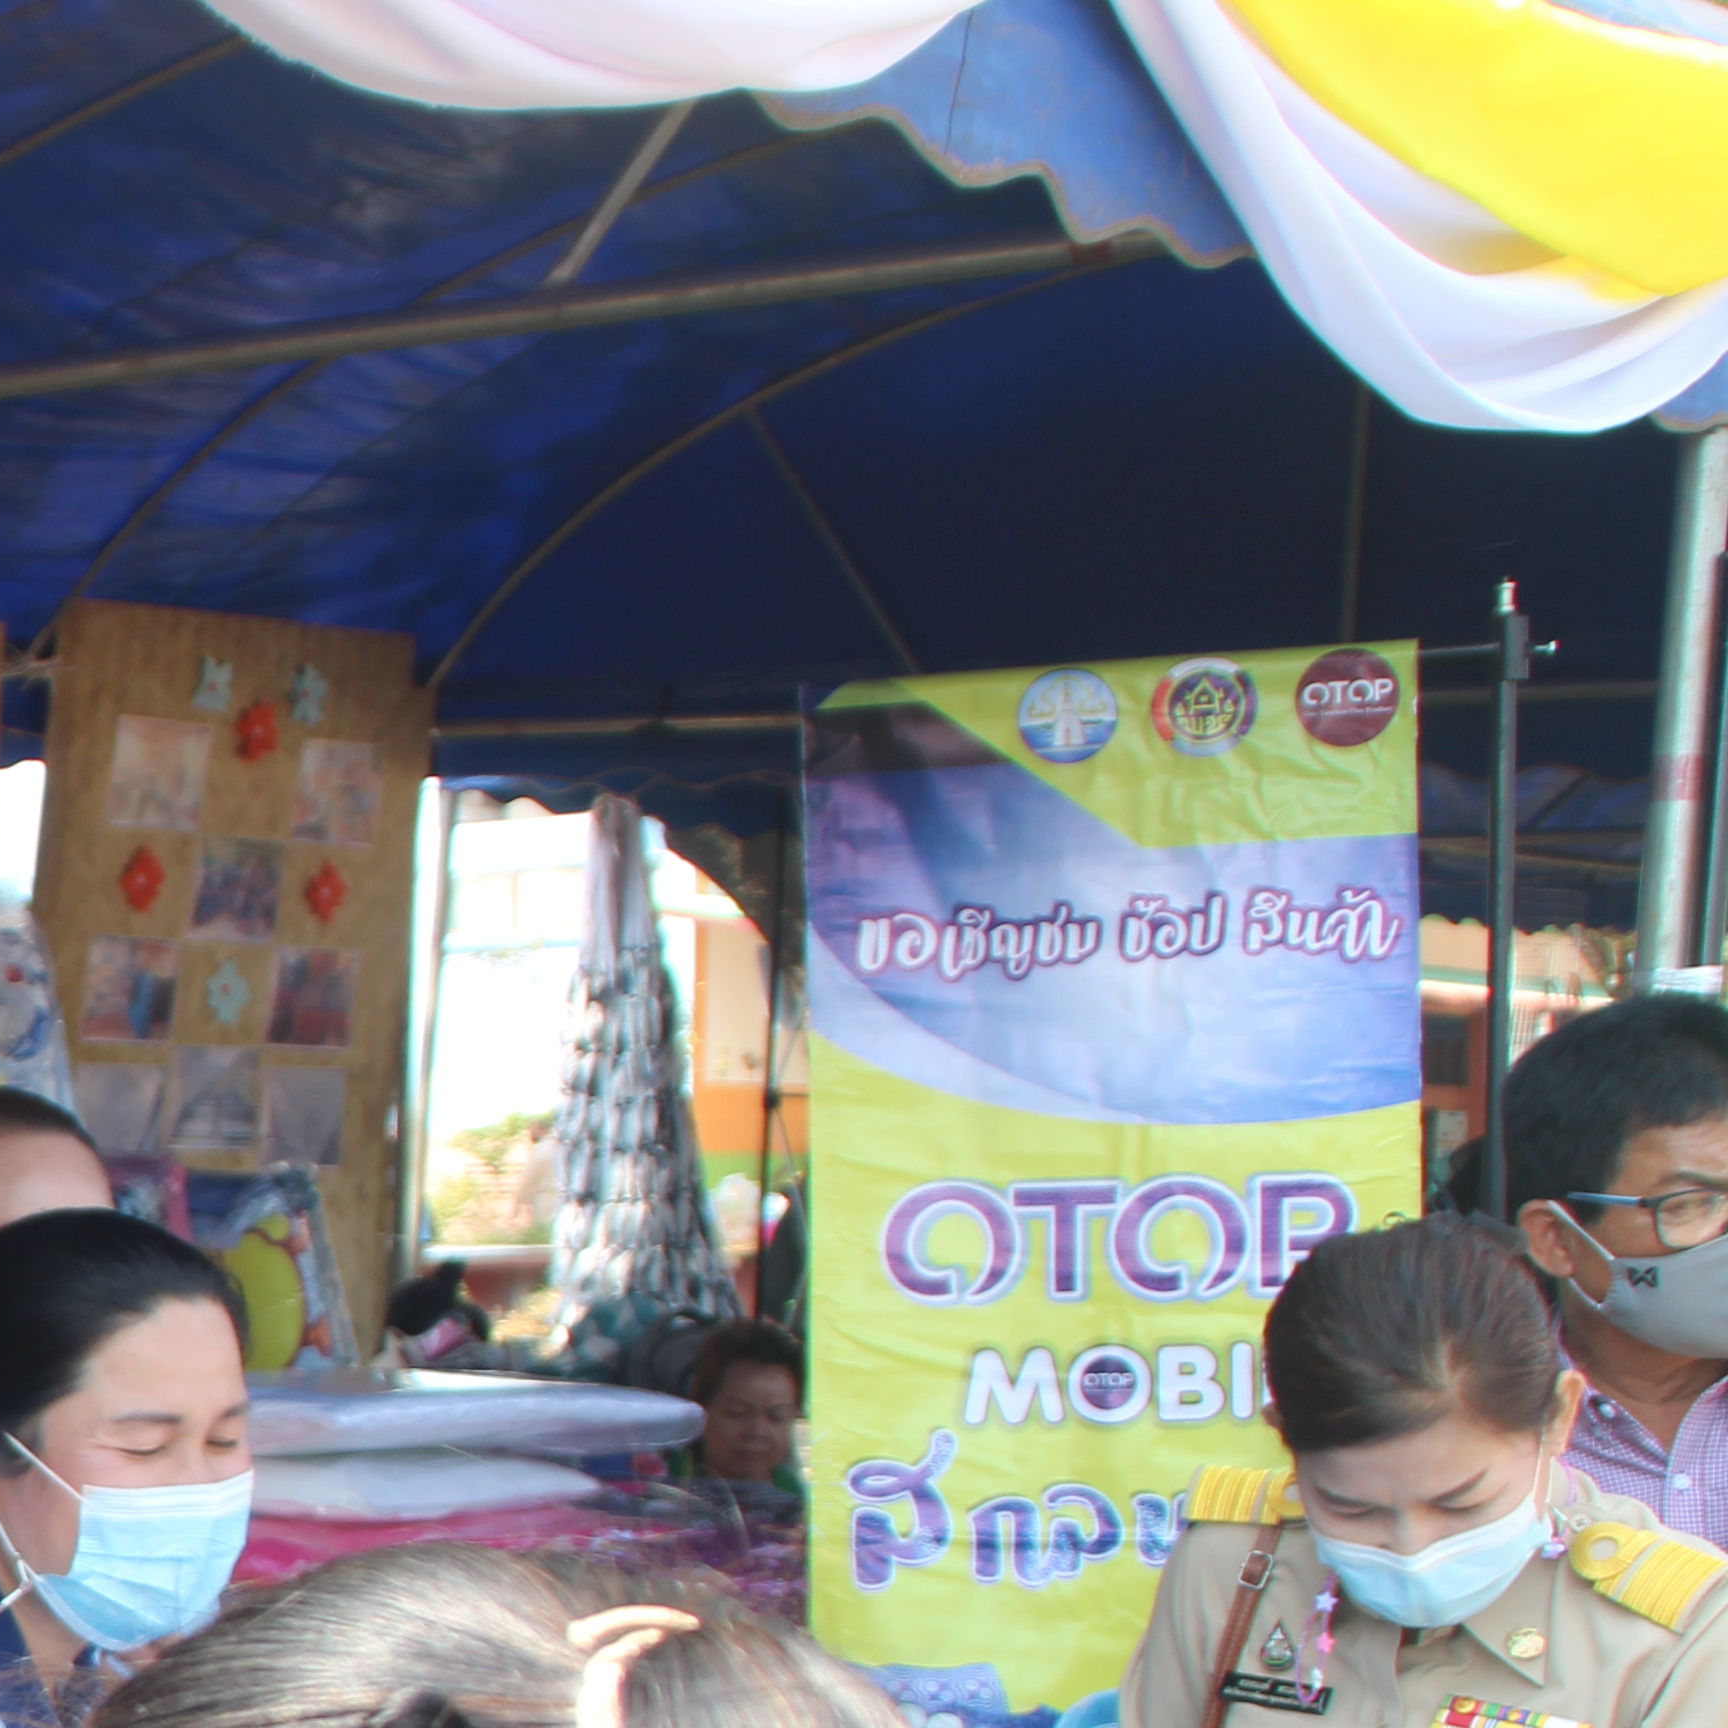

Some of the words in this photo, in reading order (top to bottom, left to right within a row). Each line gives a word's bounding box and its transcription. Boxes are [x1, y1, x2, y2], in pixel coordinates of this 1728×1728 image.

[1301, 677, 1394, 706] OTOP
[856, 903, 1100, 980] ขอเชิญชม
[1246, 888, 1400, 960] สินค้า
[882, 1171, 1358, 1301] OTOP
[963, 1342, 1273, 1425] MOBI
